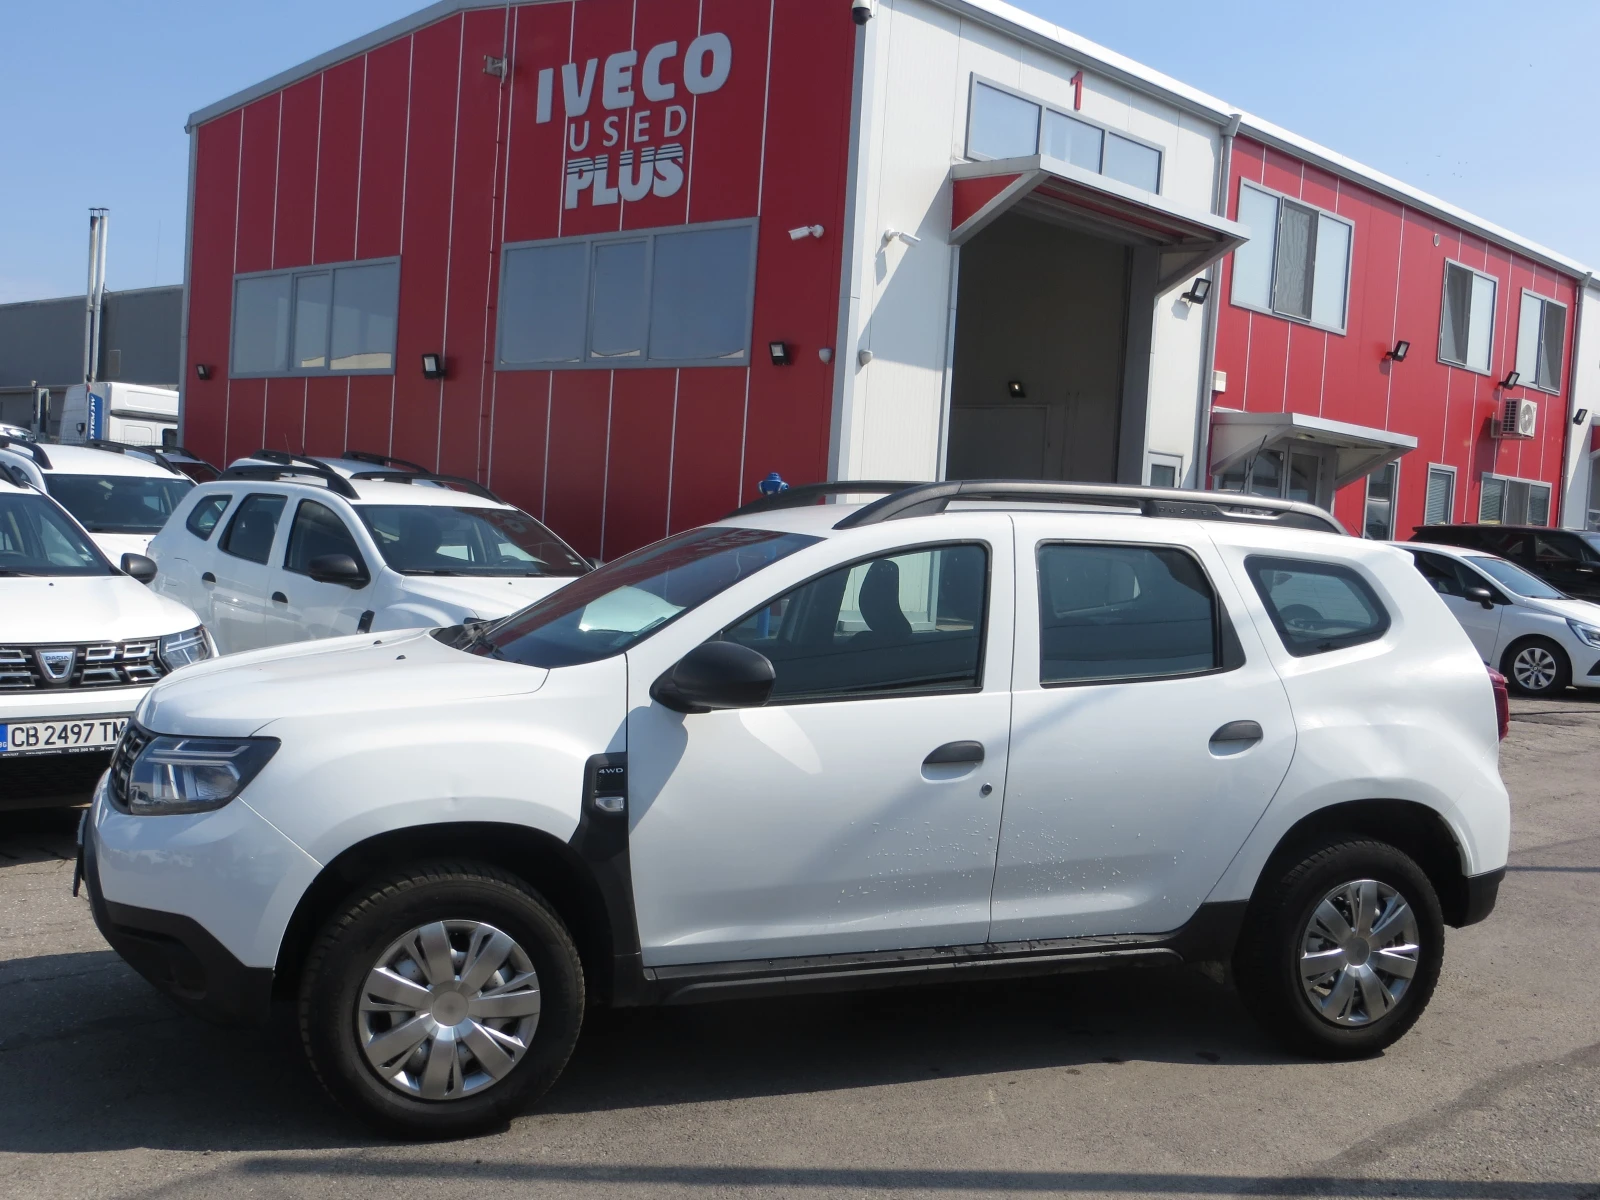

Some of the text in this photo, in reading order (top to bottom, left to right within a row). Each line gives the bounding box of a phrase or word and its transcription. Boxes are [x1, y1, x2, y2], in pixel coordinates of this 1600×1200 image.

[536, 32, 732, 124] IVECO
[1070, 70, 1083, 111] 1
[569, 105, 687, 152] USED
[564, 143, 684, 210] PLUS
[1158, 506, 1218, 517] DUSTER
[11, 726, 40, 747] CB
[44, 723, 95, 746] 2497
